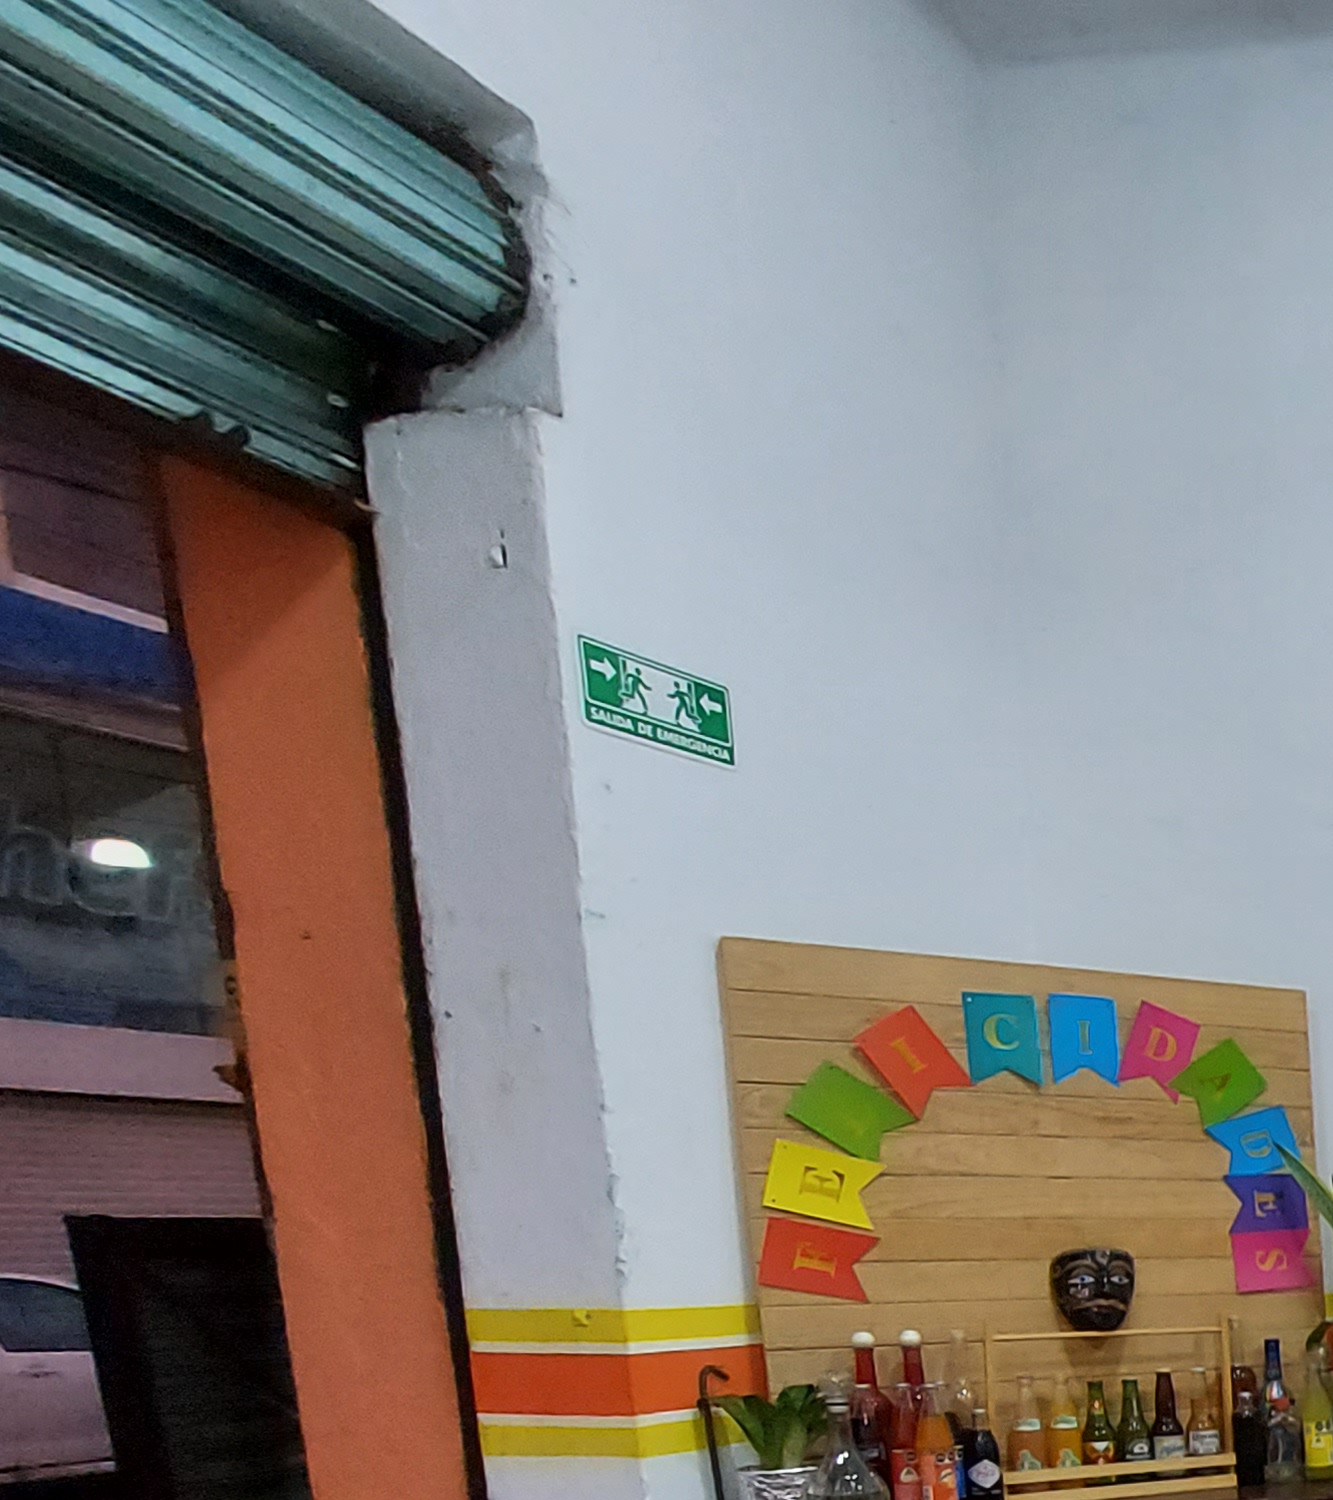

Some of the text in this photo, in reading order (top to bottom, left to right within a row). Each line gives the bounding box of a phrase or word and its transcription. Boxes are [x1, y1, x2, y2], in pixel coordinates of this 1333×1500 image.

[590, 708, 731, 761] SALIDA DE EMERGENCIA
[793, 1013, 1288, 1278] FEICIDADES
